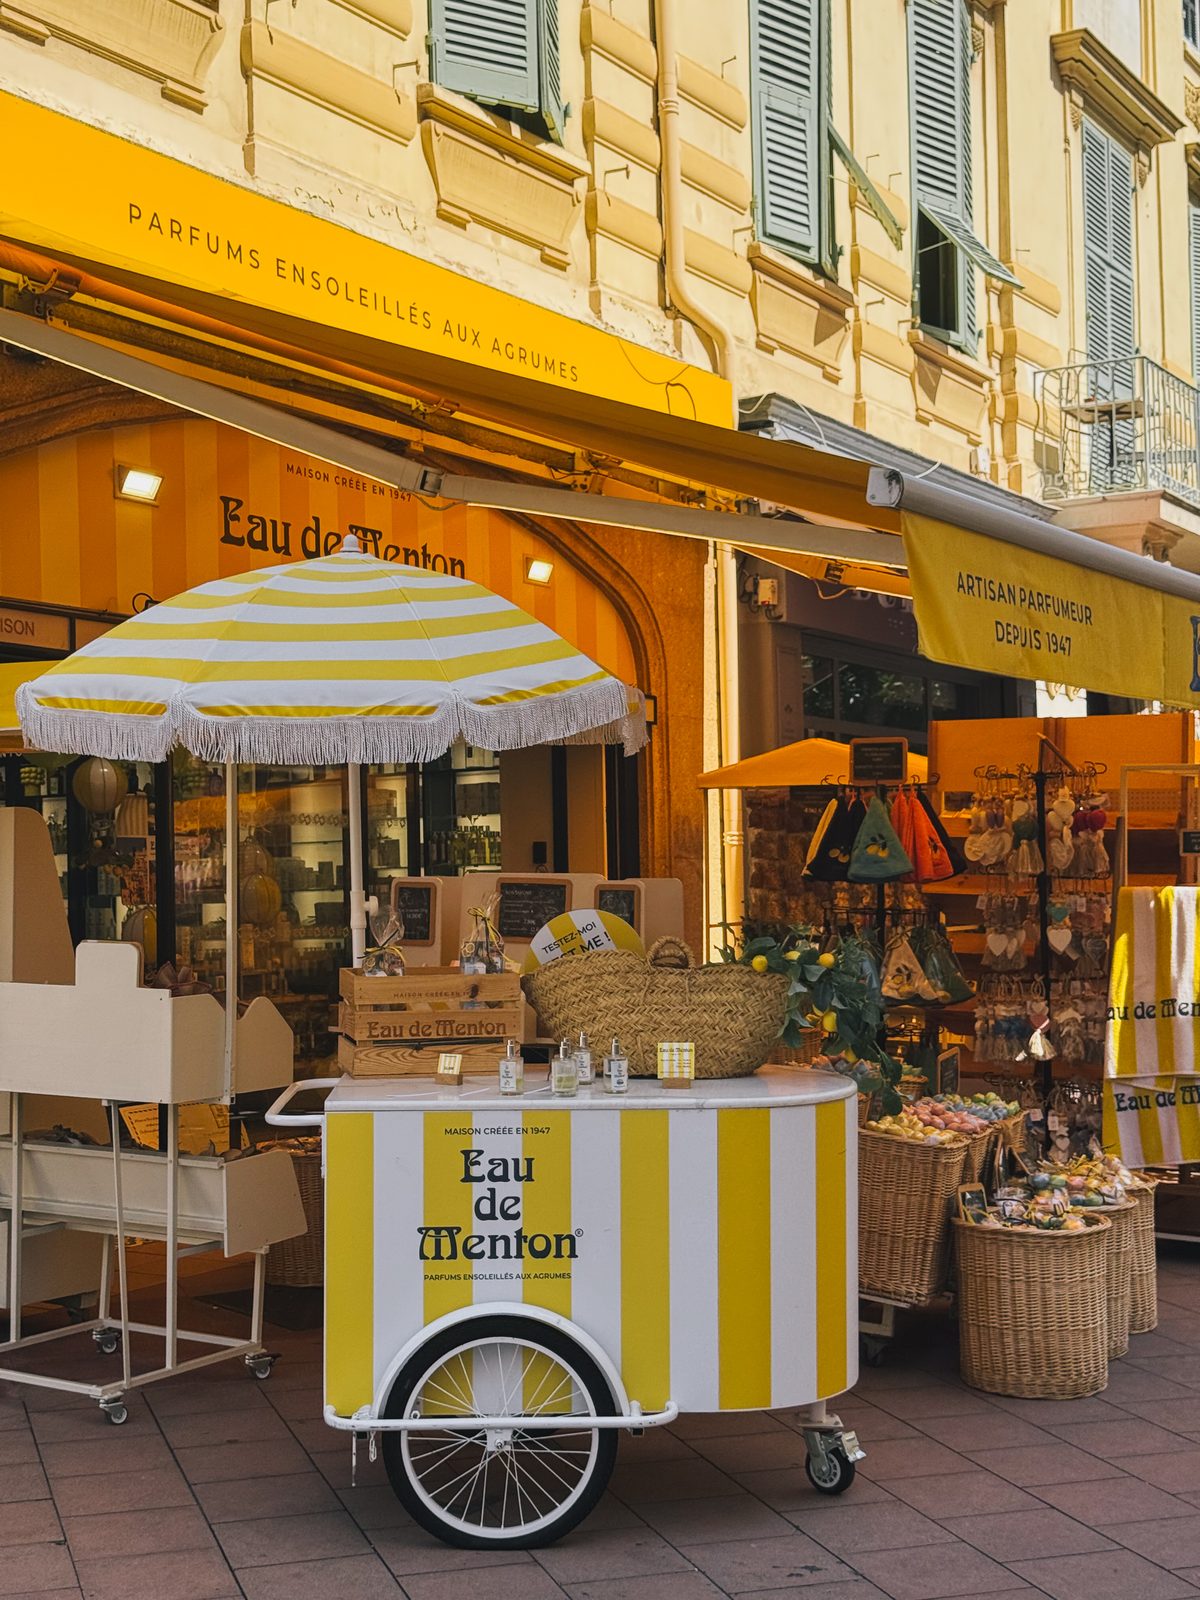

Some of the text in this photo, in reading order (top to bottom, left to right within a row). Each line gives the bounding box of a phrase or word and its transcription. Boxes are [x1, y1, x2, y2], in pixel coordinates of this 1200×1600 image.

[129, 203, 578, 382] PARFUMS ENSOLEILLÉS AUX AGRUMES
[286, 463, 412, 502] MAISON CRÉÉE EN 1947
[219, 495, 465, 579] Eau de Menton
[957, 571, 1093, 625] ARTISAN PARFUMEUR
[995, 620, 1072, 657] DEPUIS 1947
[541, 921, 597, 954] TESTEZ-MOI
[579, 935, 604, 953] ME
[1134, 1001, 1157, 1020] de
[366, 1019, 507, 1039] Eau de Menton
[1114, 1092, 1152, 1112] Eau
[1156, 1091, 1176, 1108] de
[444, 1126, 551, 1135] MAISON CRÉÉE EN 1947
[459, 1149, 535, 1183] Eau
[474, 1187, 521, 1221] de
[424, 1272, 572, 1281] PARFUMS ENSOLEILLÉS AUX AGRUMES
